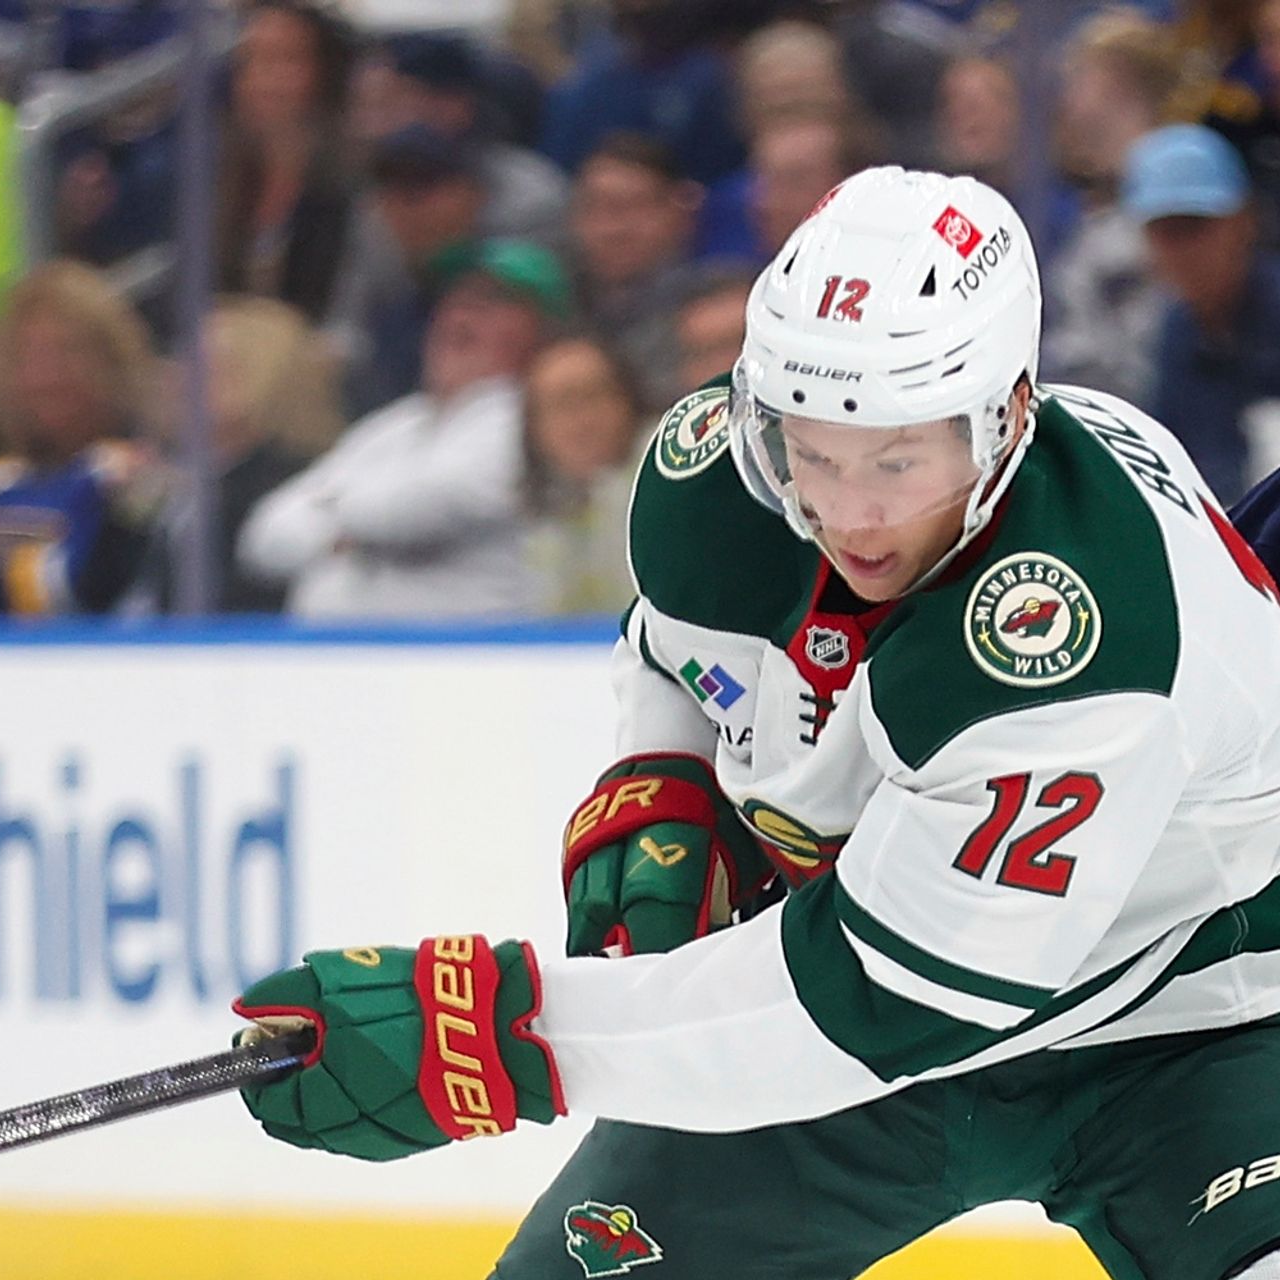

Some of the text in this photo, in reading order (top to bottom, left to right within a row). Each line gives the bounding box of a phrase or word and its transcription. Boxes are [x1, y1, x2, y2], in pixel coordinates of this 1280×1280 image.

[818, 275, 871, 323] 12
[951, 226, 1012, 301] TOYOTA
[974, 562, 1082, 675] MINNESOTA WILD
[565, 778, 663, 849] ER
[952, 770, 1106, 897] 12
